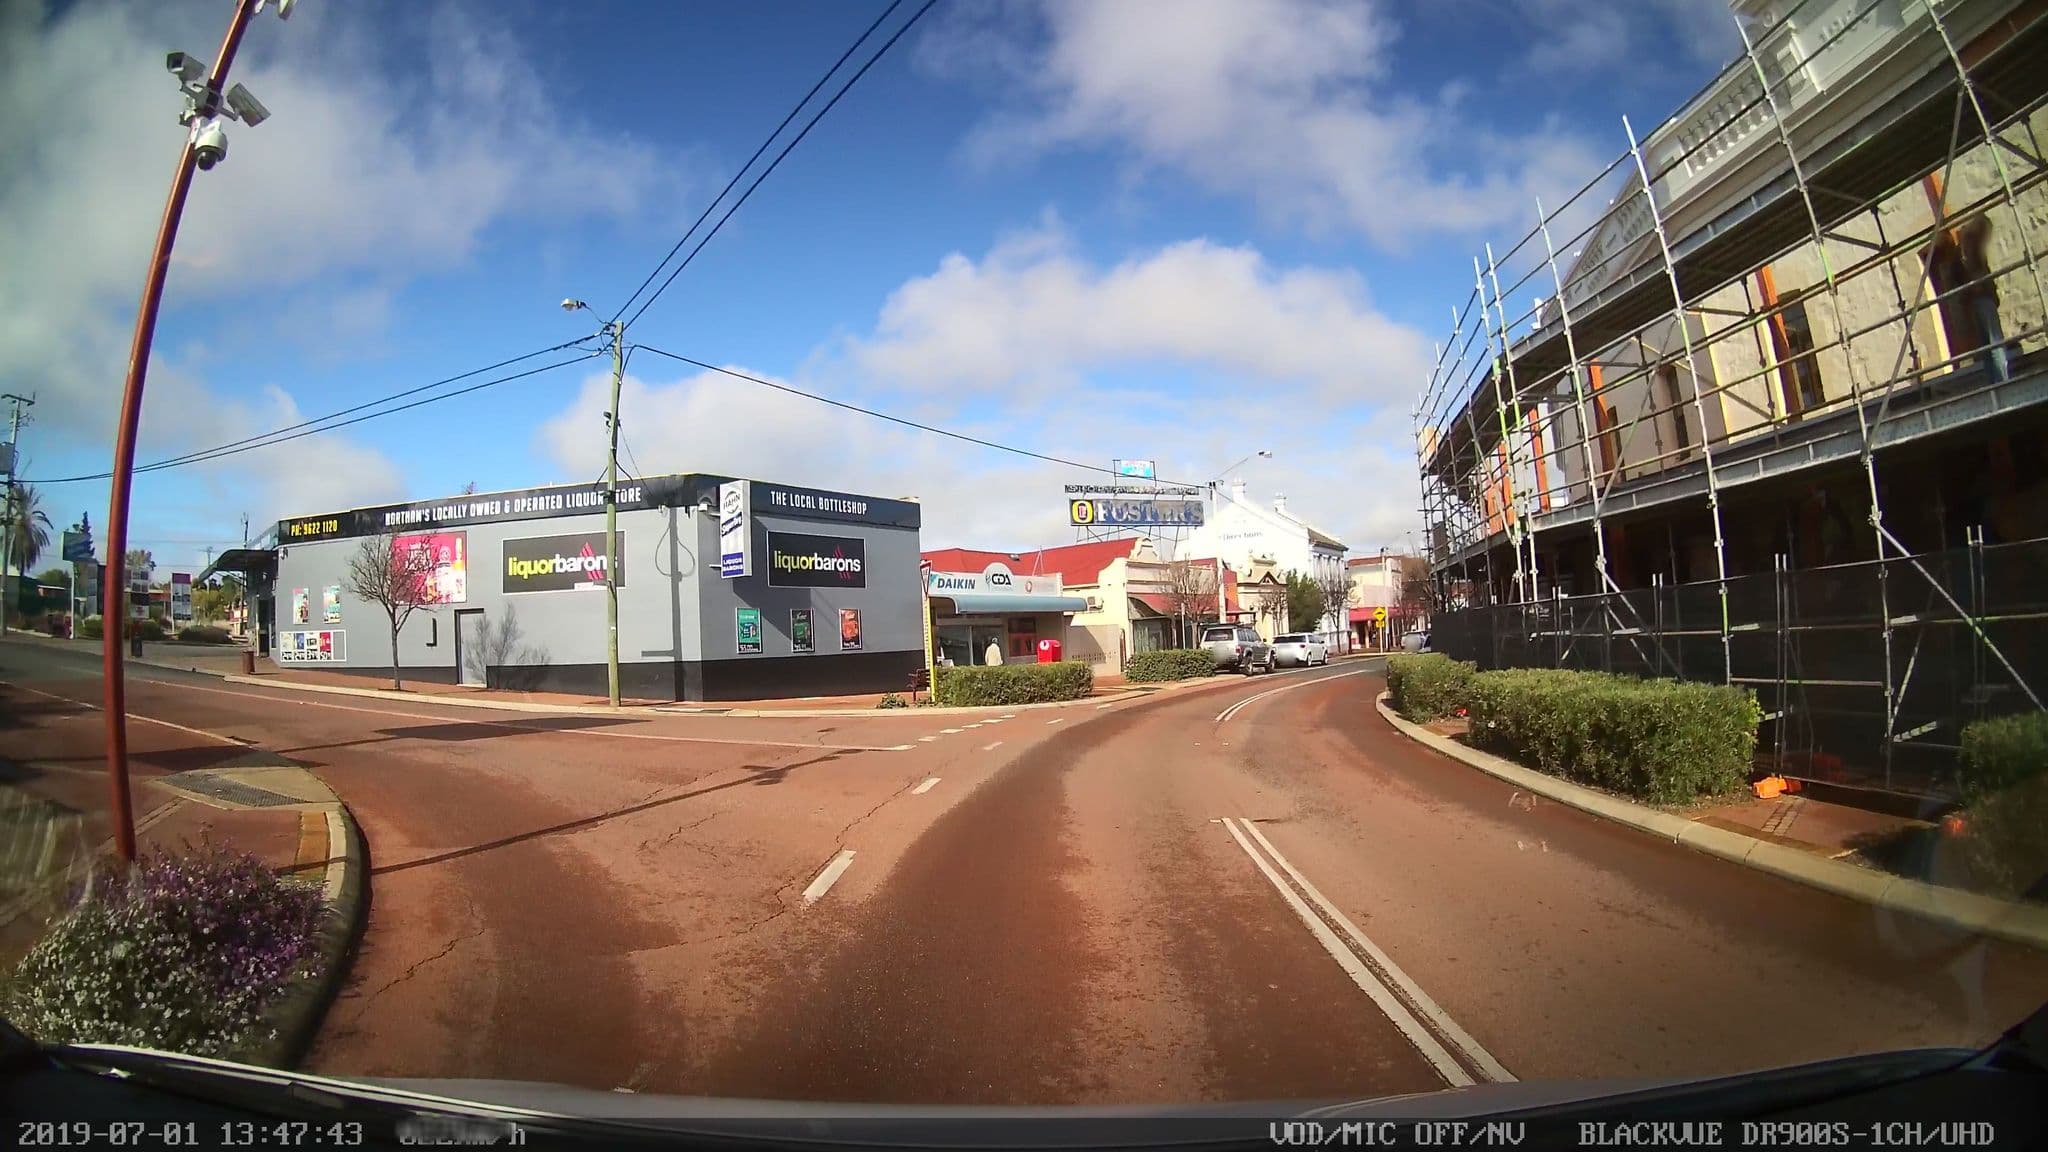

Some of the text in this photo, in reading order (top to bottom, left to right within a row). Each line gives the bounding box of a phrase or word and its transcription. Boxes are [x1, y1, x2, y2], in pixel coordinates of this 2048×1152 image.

[385, 509, 430, 526] NORTHAM'S
[432, 504, 468, 521] LOCALLY
[470, 502, 501, 517] OWNED
[514, 495, 562, 512] OPERATED
[566, 491, 604, 508] LIQUOR
[615, 487, 642, 504] TORE
[723, 493, 741, 509] HAHN
[771, 491, 867, 515] THE LOCAL BOTTLESHOP
[303, 522, 321, 536] 9622
[322, 519, 337, 534] 1120
[774, 549, 861, 573] liquorbarons
[937, 577, 976, 590] DAIKIN
